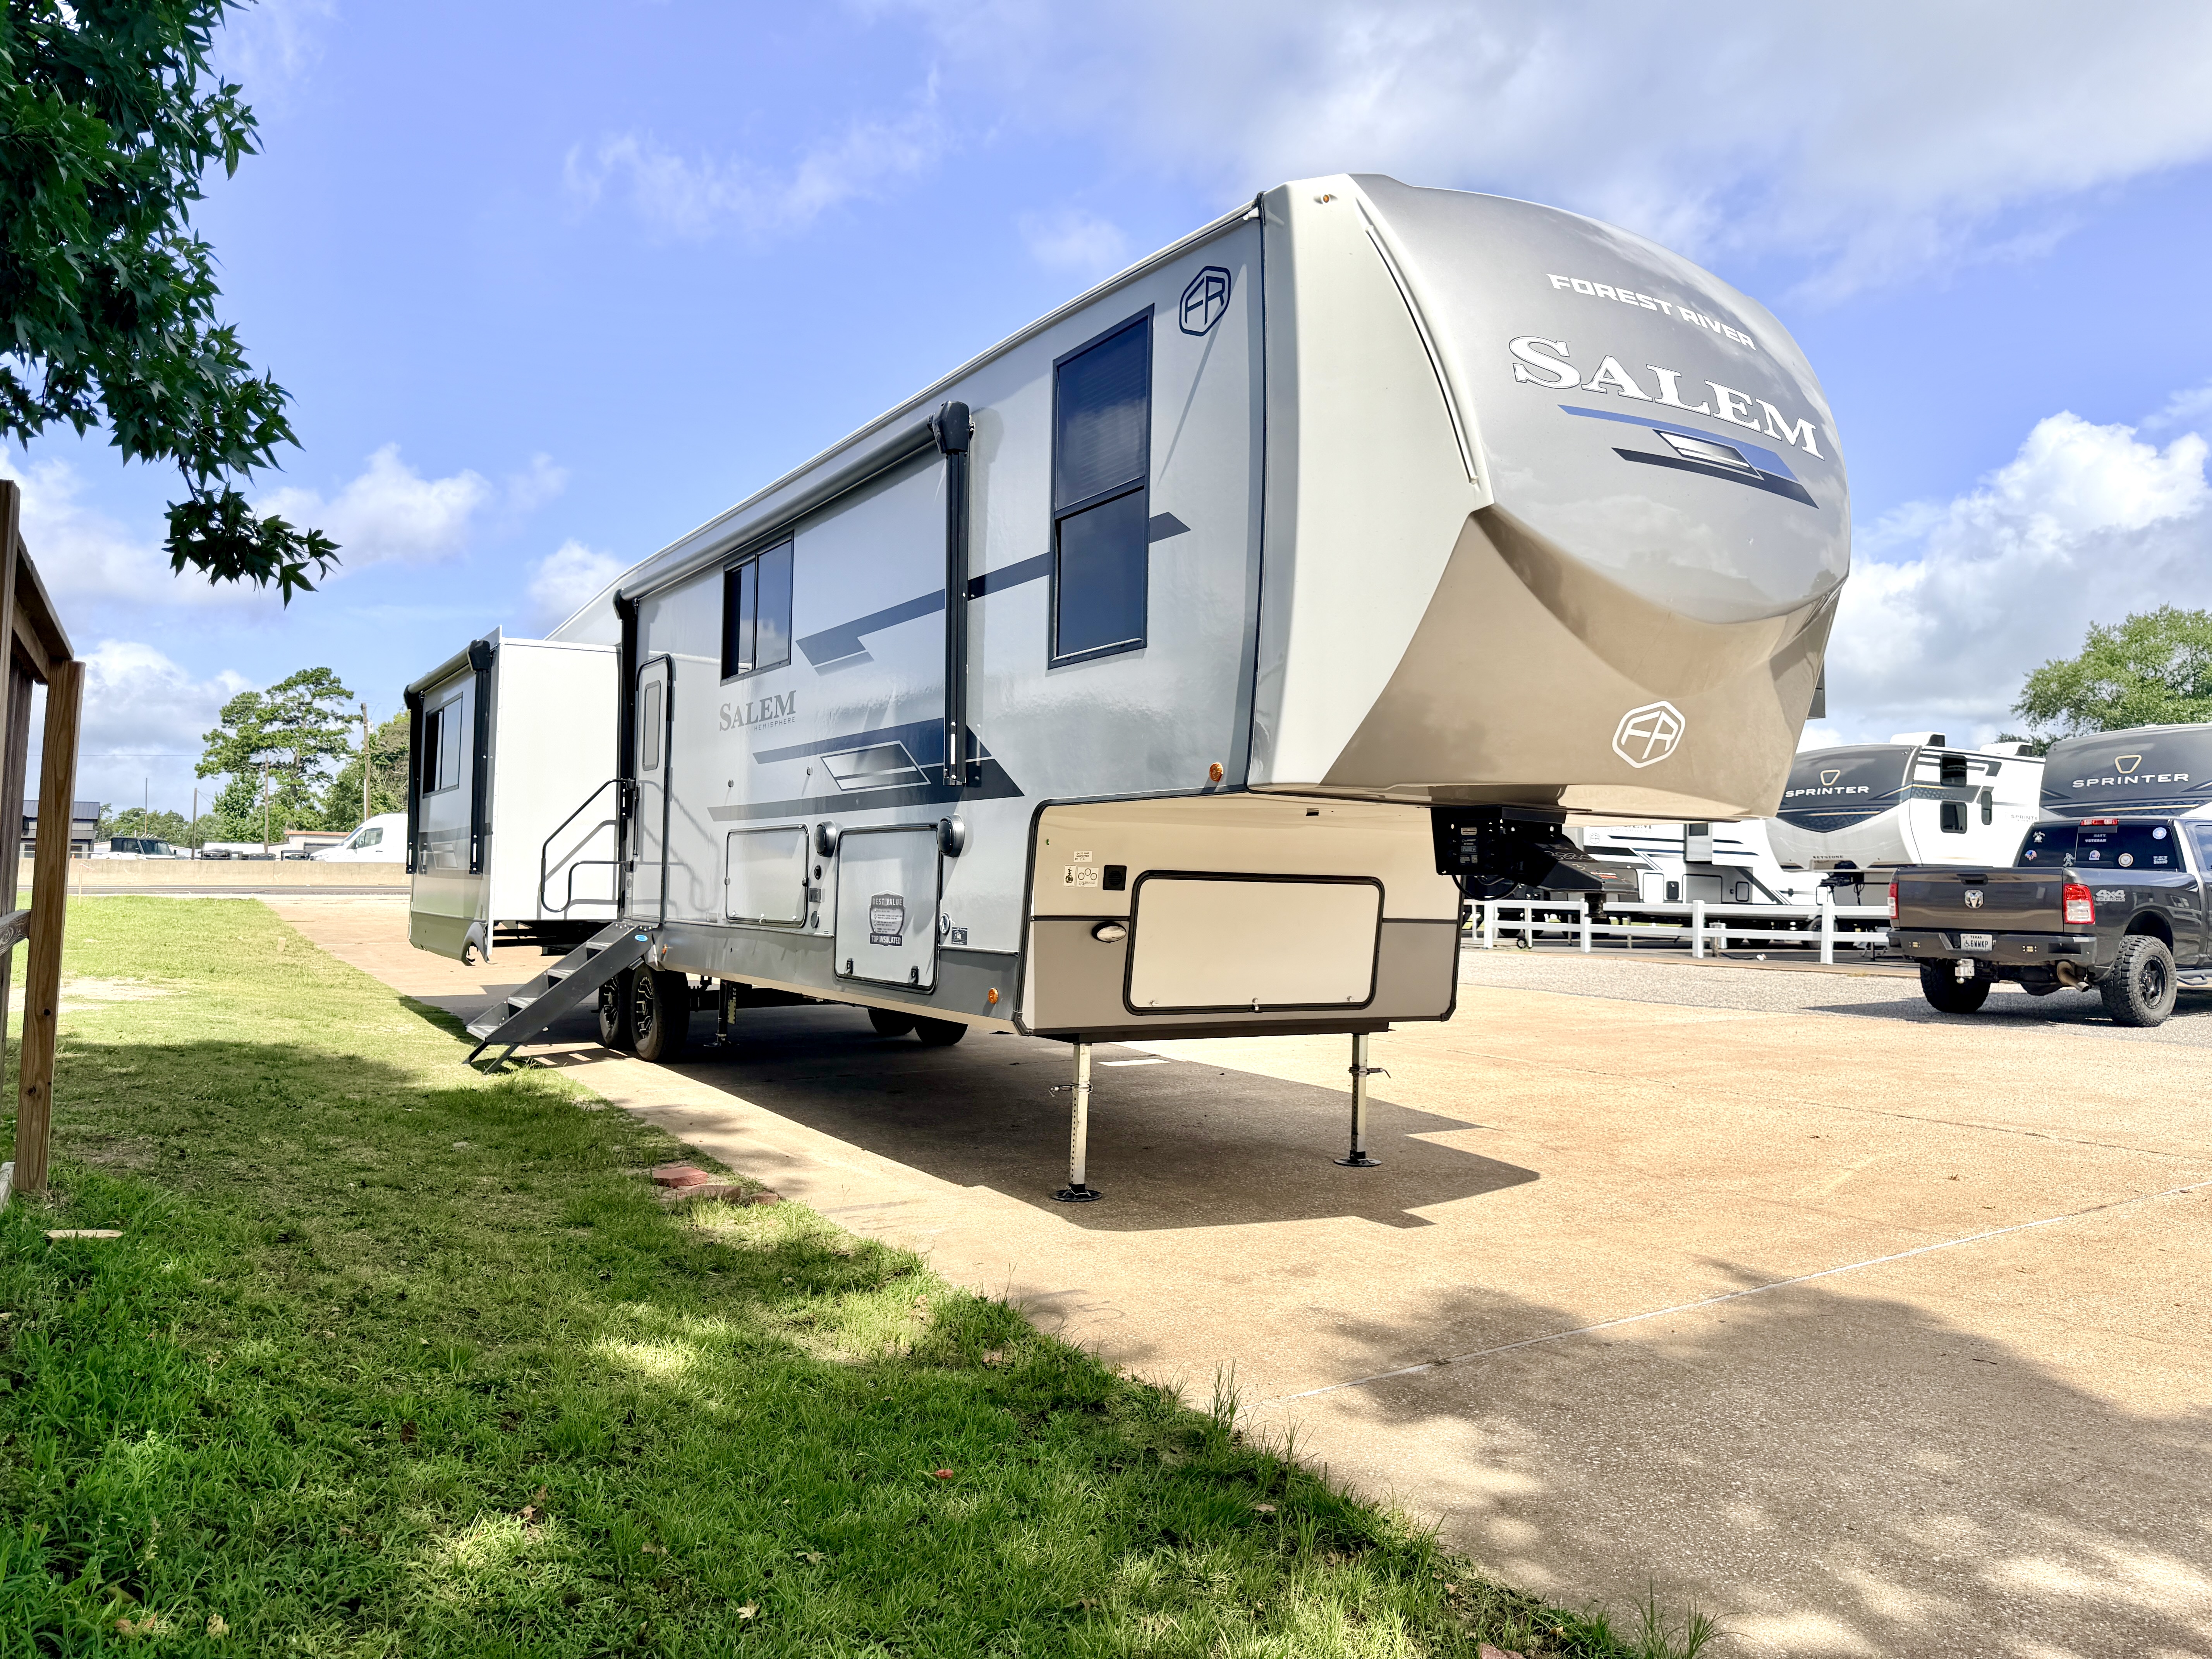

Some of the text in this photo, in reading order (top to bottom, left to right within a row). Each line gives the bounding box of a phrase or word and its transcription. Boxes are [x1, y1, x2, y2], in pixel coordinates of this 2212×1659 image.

[1546, 273, 1757, 350] FOREST RIVER
[1509, 336, 1825, 460] SALEM
[719, 690, 796, 731] SALEM
[754, 716, 796, 731] HEMISPHERE
[2072, 773, 2189, 788] SPRINTER
[1785, 786, 1869, 798] SPRINTER
[879, 936, 901, 944] INSULATED
